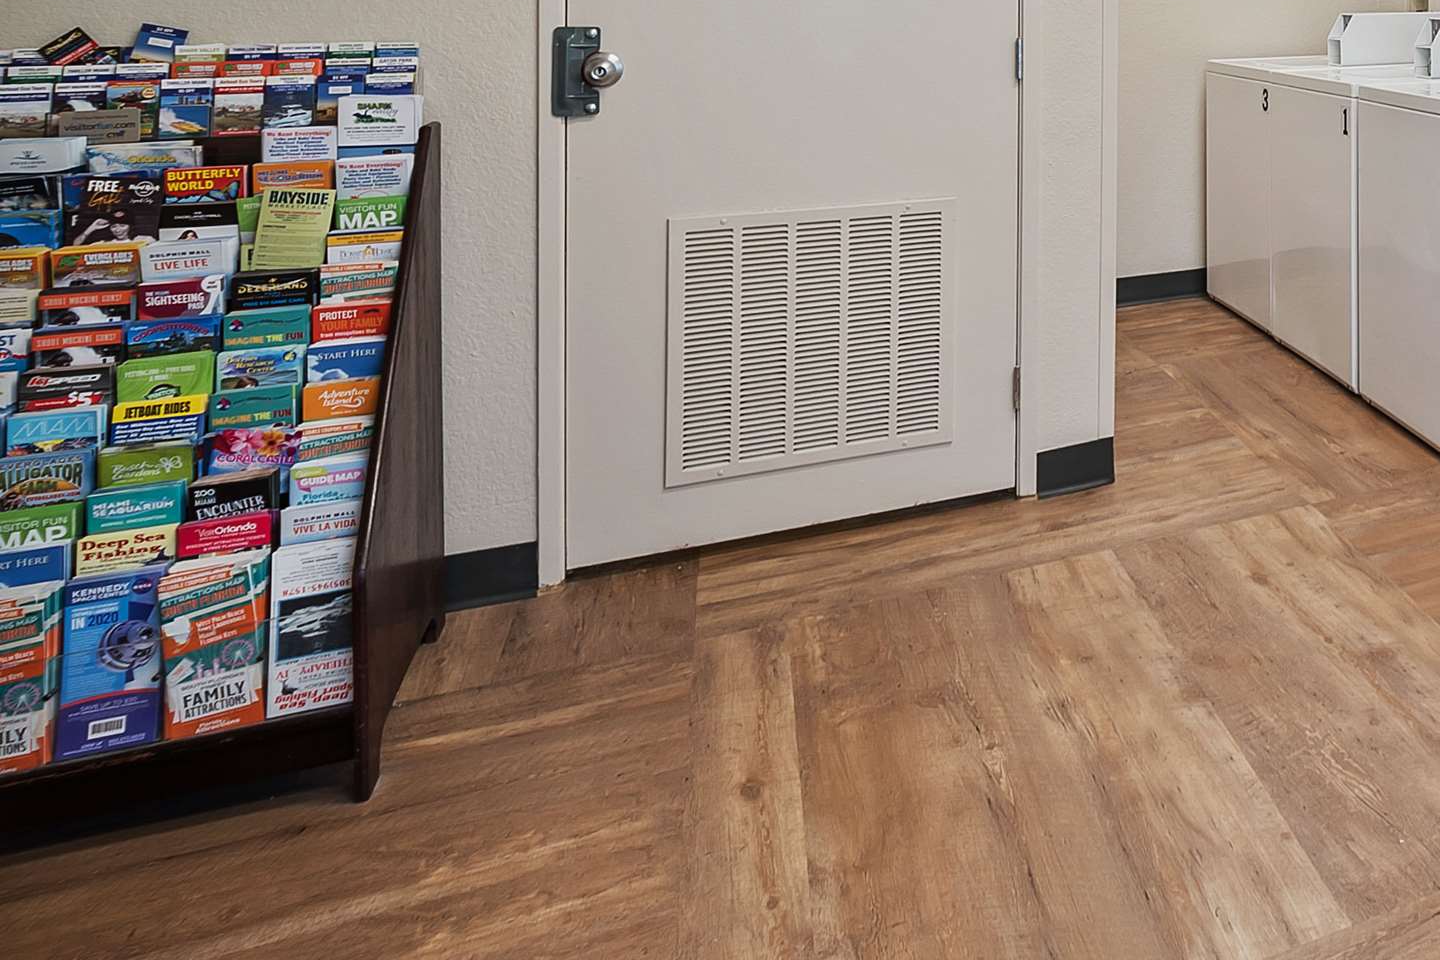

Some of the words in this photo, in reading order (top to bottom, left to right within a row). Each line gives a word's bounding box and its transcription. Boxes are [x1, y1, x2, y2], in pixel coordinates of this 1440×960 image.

[357, 102, 392, 110] SHARK
[1262, 88, 1269, 112] 3
[1342, 109, 1348, 135] 1
[167, 168, 240, 181] BUTTERFLY
[87, 180, 121, 192] FREE
[167, 180, 214, 192] WORLD
[269, 190, 329, 205] BAYSIDE
[340, 204, 376, 214] VISITOR
[378, 203, 397, 212] FUN
[340, 211, 398, 230] MAP
[154, 260, 179, 271] LIVE
[184, 258, 208, 268] LIFE
[321, 272, 376, 285] ATTRACTIONS
[145, 292, 205, 307] SIGHTSEEING
[320, 309, 358, 321] PROTECT
[320, 319, 348, 331] YOUR
[350, 317, 383, 329] FAMILY
[266, 334, 283, 342] THE
[285, 331, 304, 341] FUN
[318, 350, 348, 360] START
[351, 348, 377, 358] HERE
[318, 388, 370, 401] Adventure
[322, 397, 353, 407] Island
[123, 404, 162, 420] JETBOAT
[163, 401, 191, 415] RIDES
[254, 411, 272, 421] THE
[272, 408, 292, 419] FUN
[216, 454, 256, 464] CORAL
[300, 475, 334, 486] GUIDE
[335, 471, 361, 481] MAP
[193, 488, 215, 498] ZOO
[302, 490, 338, 501] Florida
[92, 500, 131, 511] MIAMI
[194, 498, 216, 506] MIAMI
[196, 495, 264, 520] ENCOUNTER
[92, 500, 175, 518] SEAQUARIUM
[42, 516, 68, 526] FUN
[293, 514, 331, 523] DOLPHIN
[293, 525, 316, 535] VIVE
[319, 522, 331, 531] LA
[334, 519, 357, 529] VIDA
[81, 539, 129, 551] Deep
[133, 532, 166, 544] Sea
[83, 544, 162, 561] Fishing
[15, 554, 49, 569] HERE
[72, 581, 130, 598] KENNEDY
[99, 589, 130, 598] CENTER
[160, 584, 225, 608] ATTRACTIONS
[225, 576, 245, 587] MAP
[71, 616, 85, 631] IN
[87, 611, 119, 627] 2020
[183, 680, 245, 708] FAMILY
[313, 691, 349, 705] Deep
[184, 693, 247, 719] ATTRACTIONS
[279, 700, 306, 711] Sea
